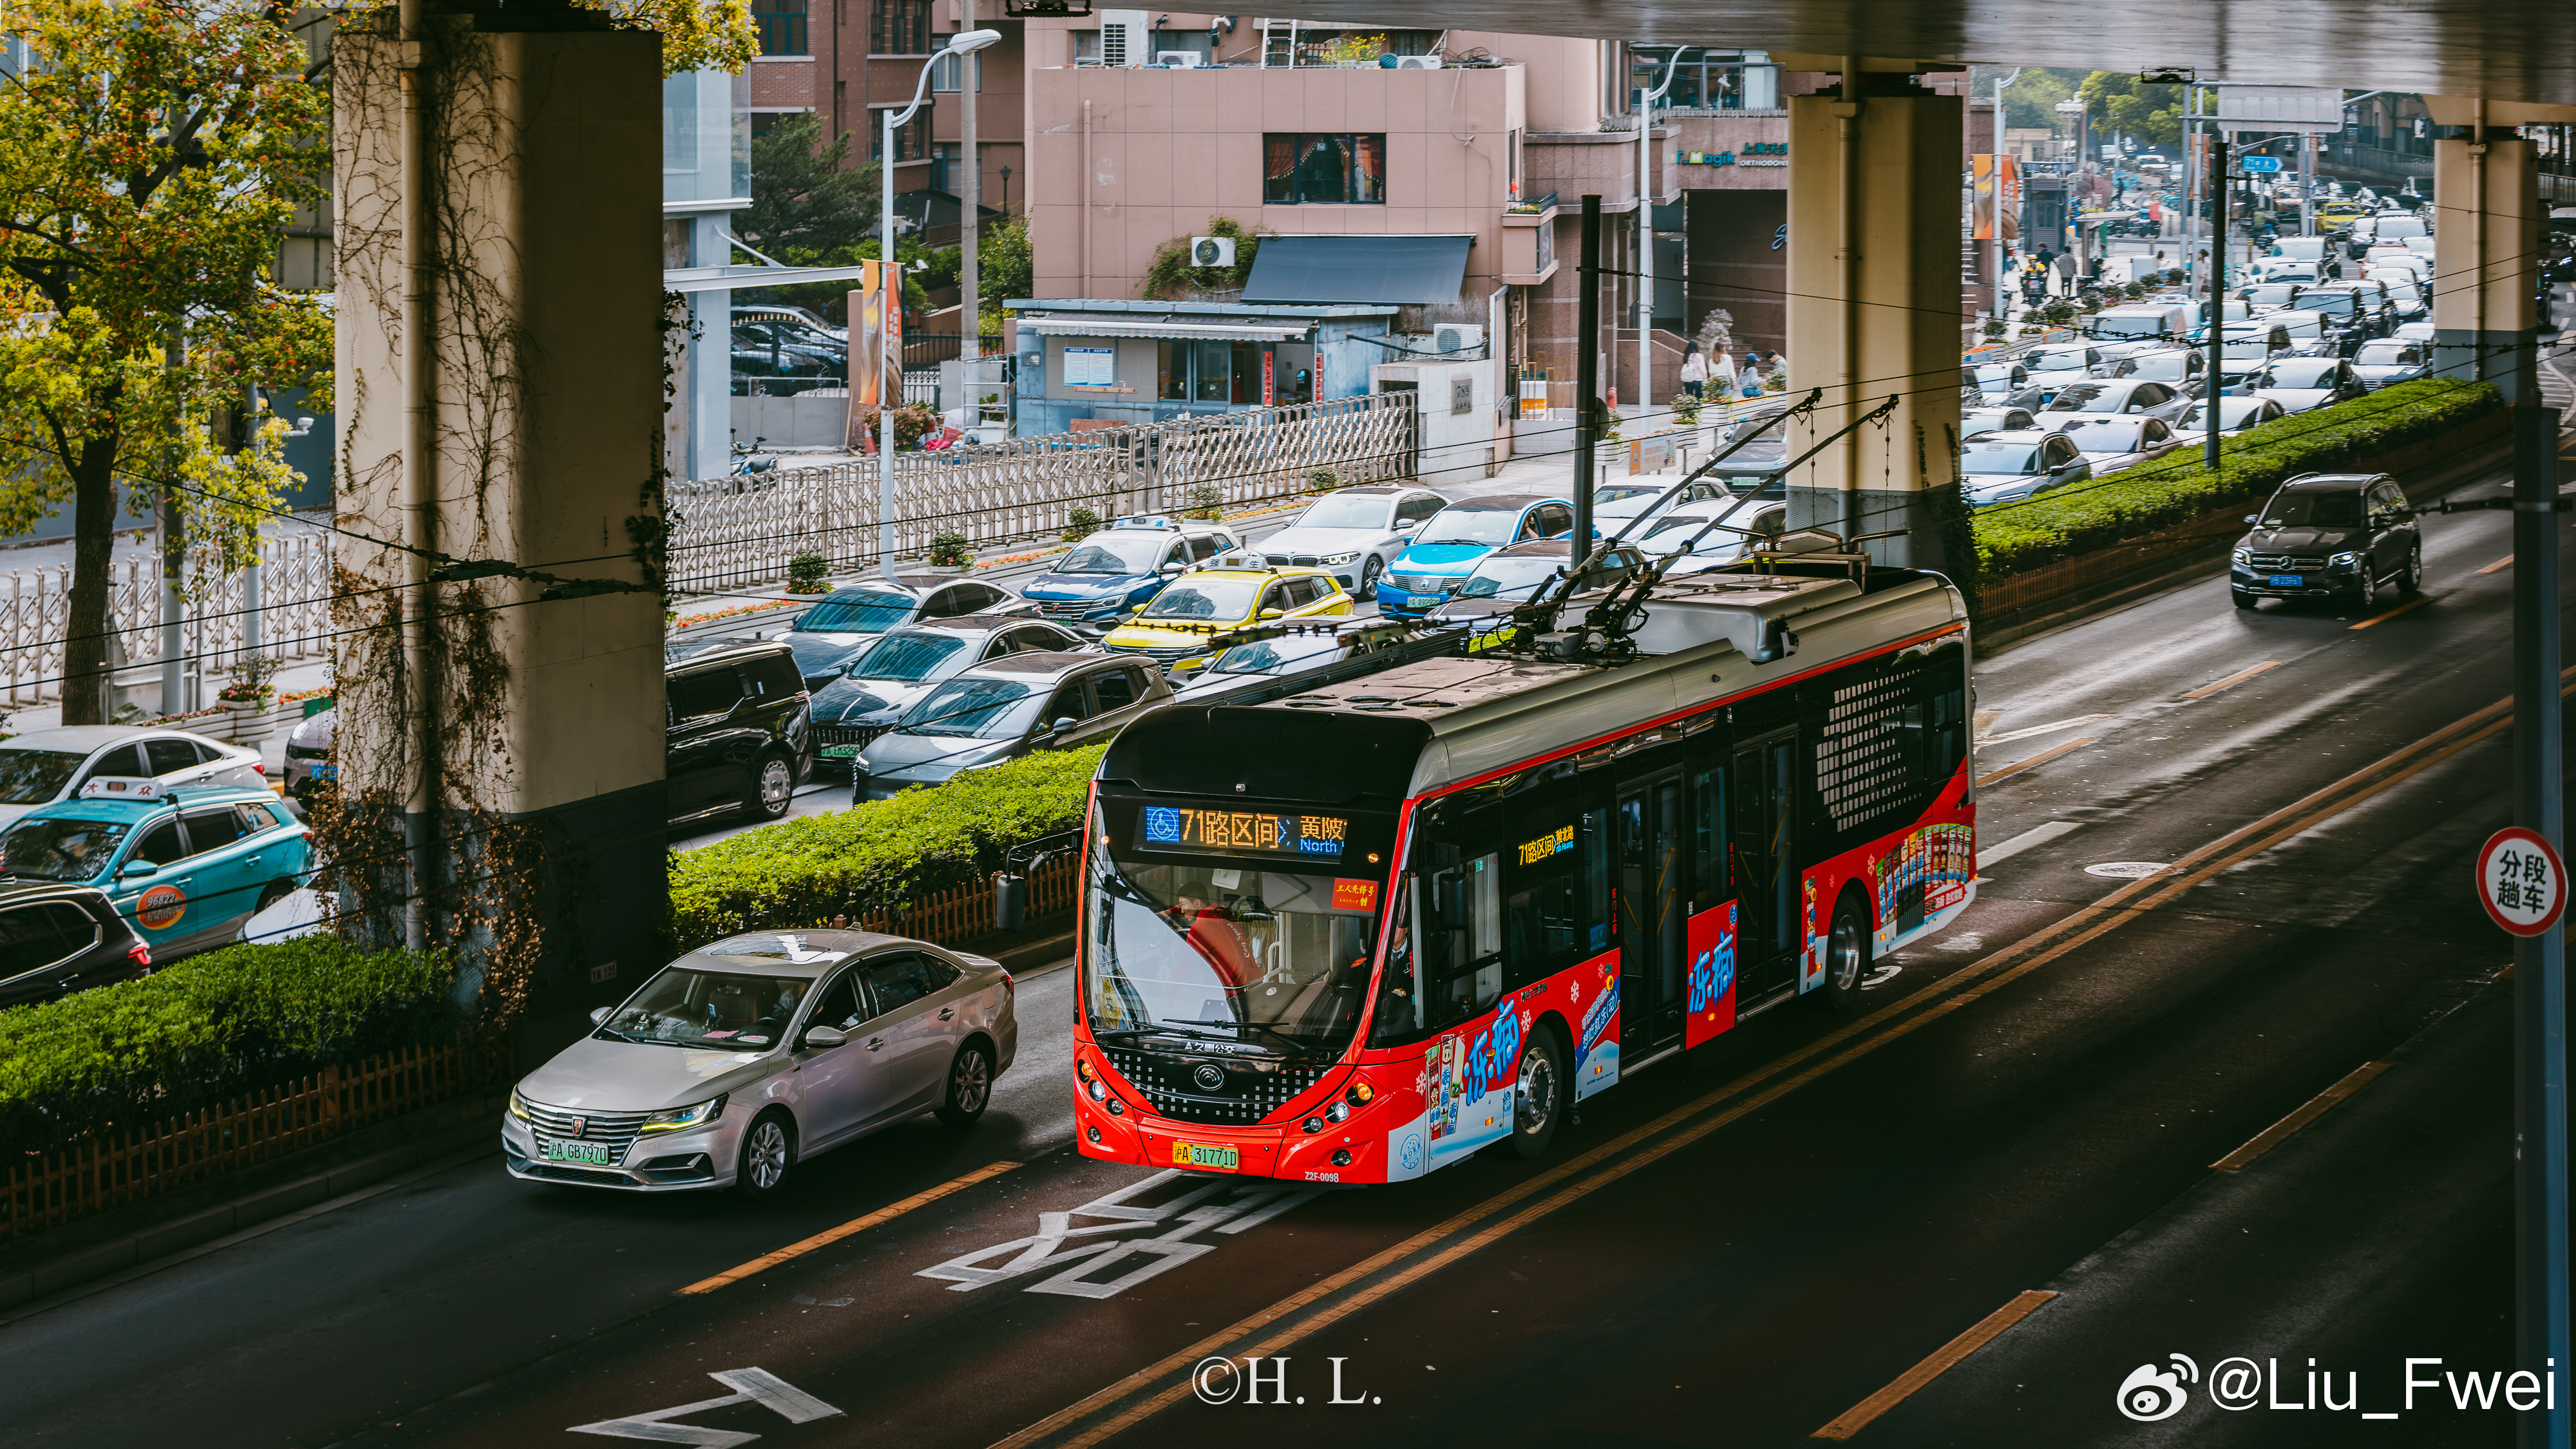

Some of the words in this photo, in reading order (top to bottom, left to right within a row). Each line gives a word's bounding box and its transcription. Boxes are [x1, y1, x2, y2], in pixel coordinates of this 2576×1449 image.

[1457, 384, 1470, 398] 789
[1179, 809, 1280, 849] 71路区间
[1300, 815, 1347, 840] 黄陂
[1300, 838, 1338, 853] North
[1519, 834, 1554, 866] 71路区间
[2499, 849, 2547, 886] 分段
[1336, 884, 1374, 897] 工人先锋号
[2496, 878, 2546, 915] 趟车
[147, 893, 176, 908] 96822
[1194, 1041, 1236, 1056] 久事公交
[549, 1142, 563, 1157] 沪A
[568, 1144, 607, 1162] GB7970
[1175, 1146, 1189, 1161] 沪A
[1194, 1148, 1237, 1166] 31771D
[1305, 1171, 1340, 1183] Z2F-0098
